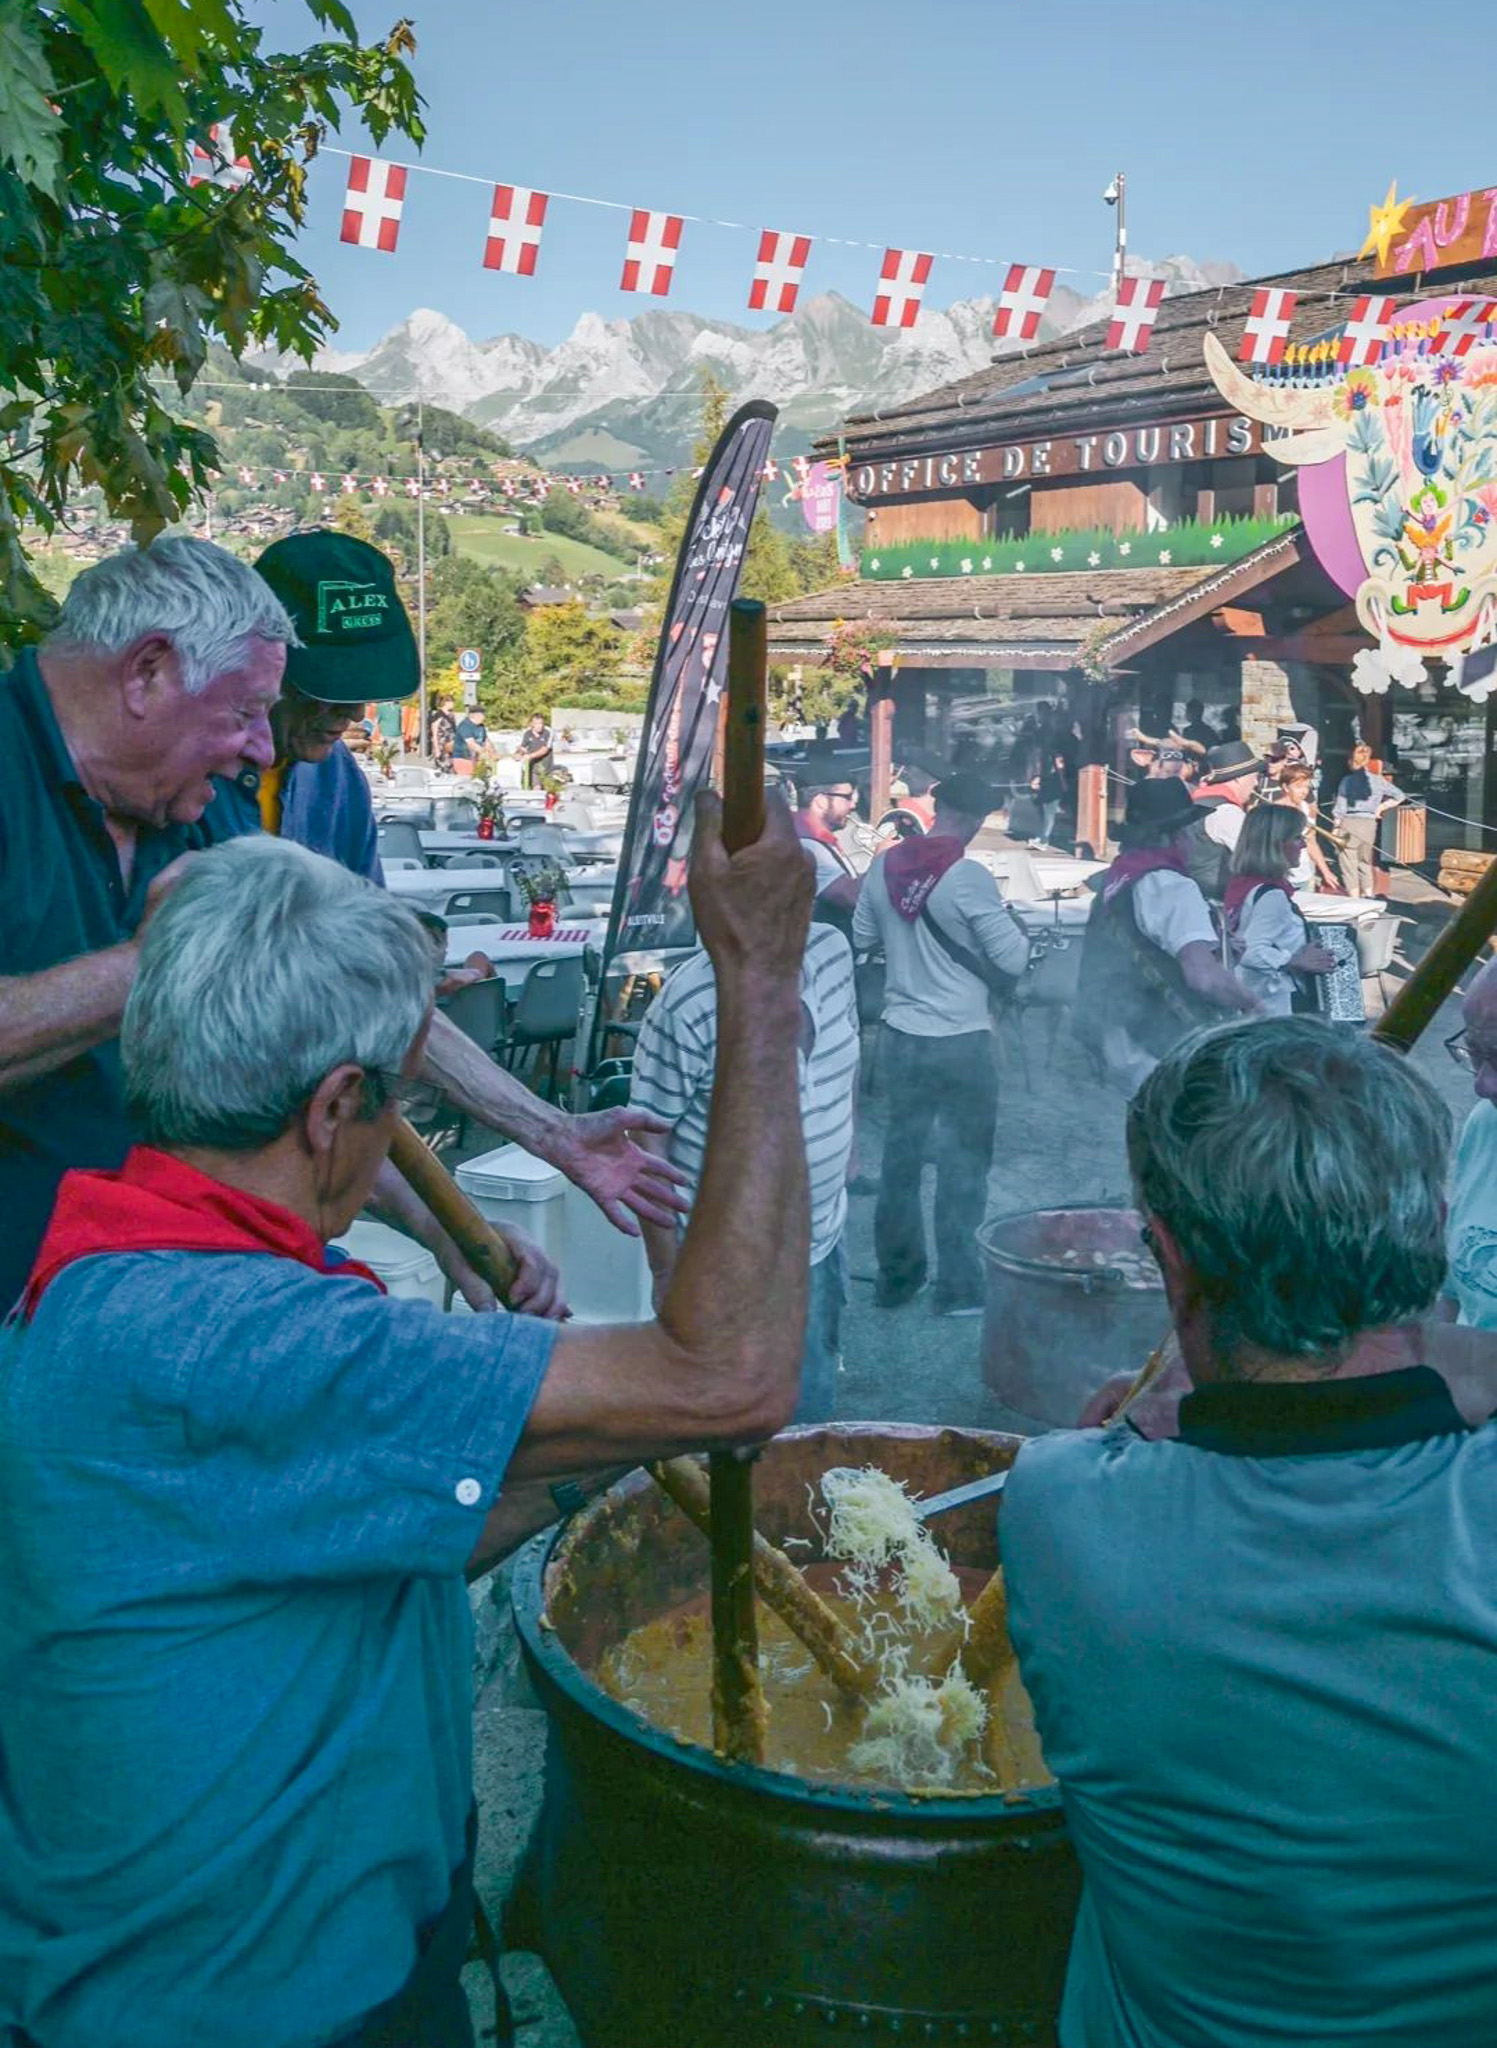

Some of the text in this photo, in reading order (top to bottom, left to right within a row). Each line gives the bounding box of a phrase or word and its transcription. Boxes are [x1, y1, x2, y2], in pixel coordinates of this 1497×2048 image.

[1394, 192, 1470, 273] AU
[858, 452, 981, 496] OFFICE
[1002, 442, 1050, 478] DE
[330, 593, 389, 613] ALEX
